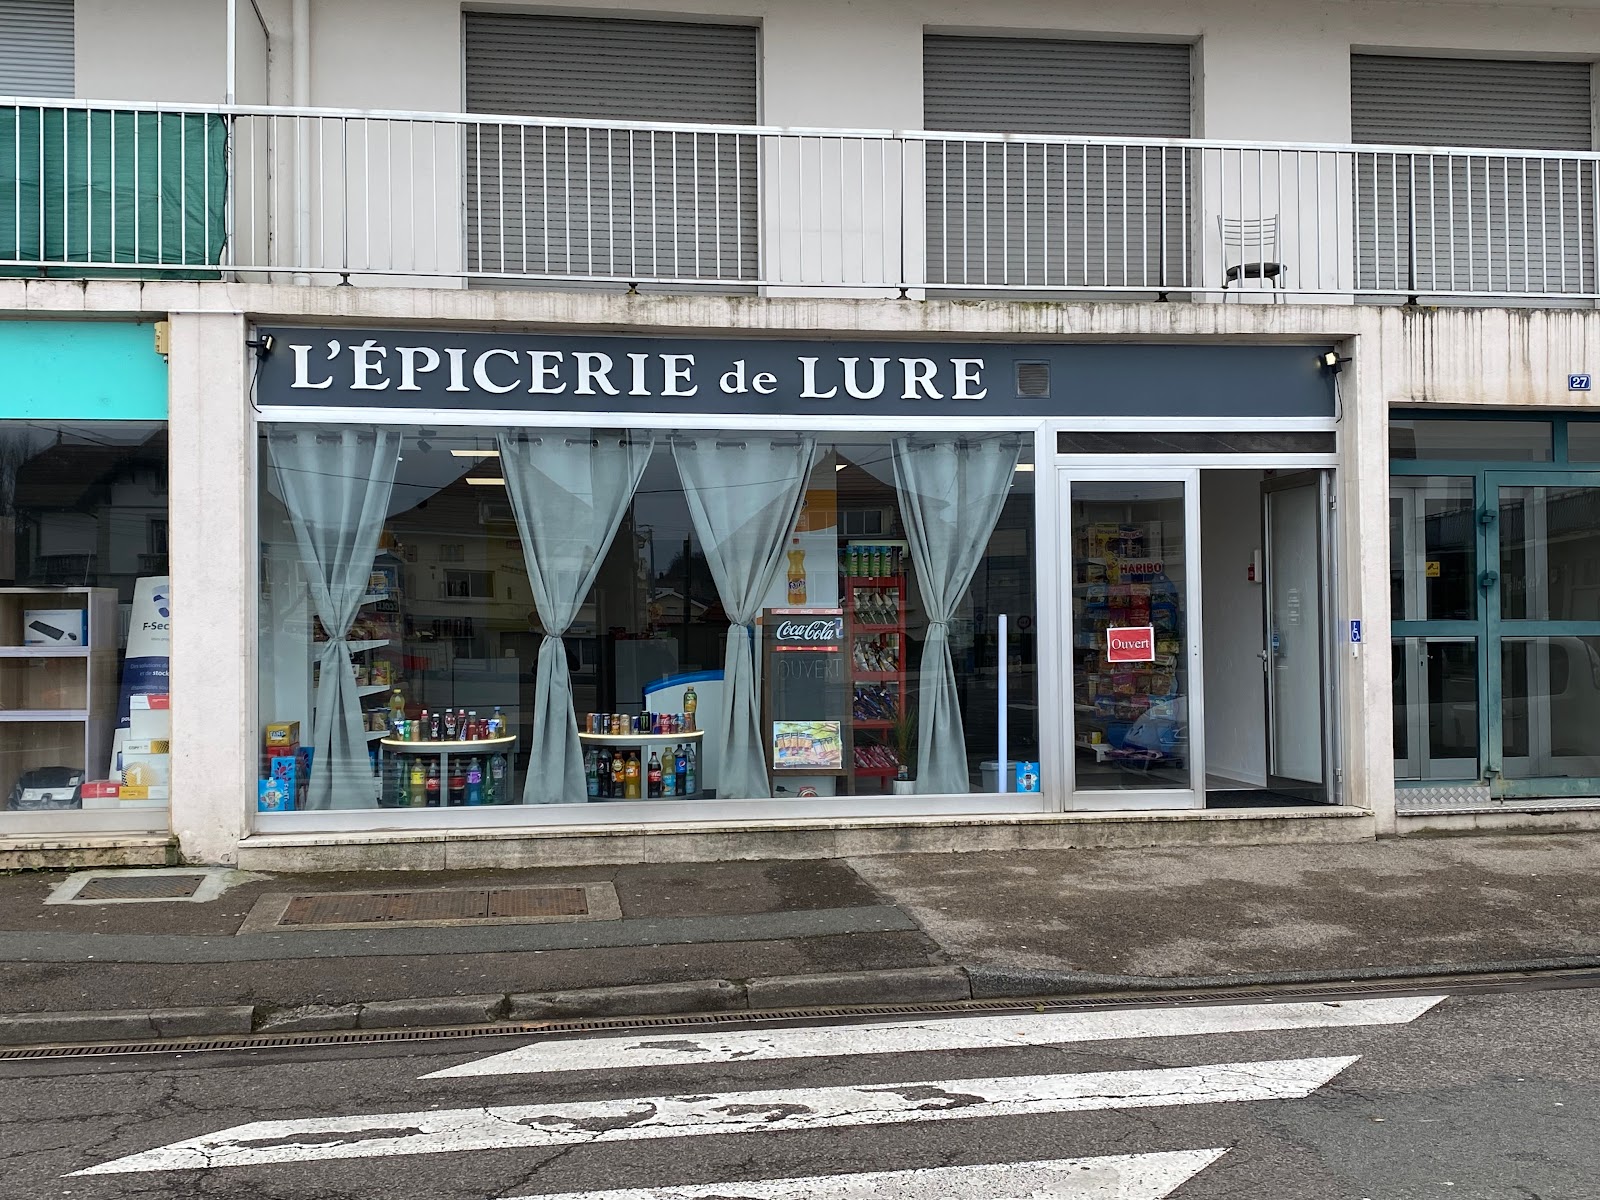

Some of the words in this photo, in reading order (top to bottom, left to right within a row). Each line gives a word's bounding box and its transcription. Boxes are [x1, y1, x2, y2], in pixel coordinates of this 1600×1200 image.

[289, 339, 698, 397] L'ÉPICERIE
[719, 359, 778, 394] de
[797, 356, 988, 400] LURE
[1572, 377, 1588, 388] 27
[1120, 562, 1162, 574] HARIBO
[776, 620, 836, 640] Coca-Cola
[1111, 638, 1150, 650] Ouvert
[777, 658, 843, 680] OUVERT
[132, 767, 141, 785] 1
